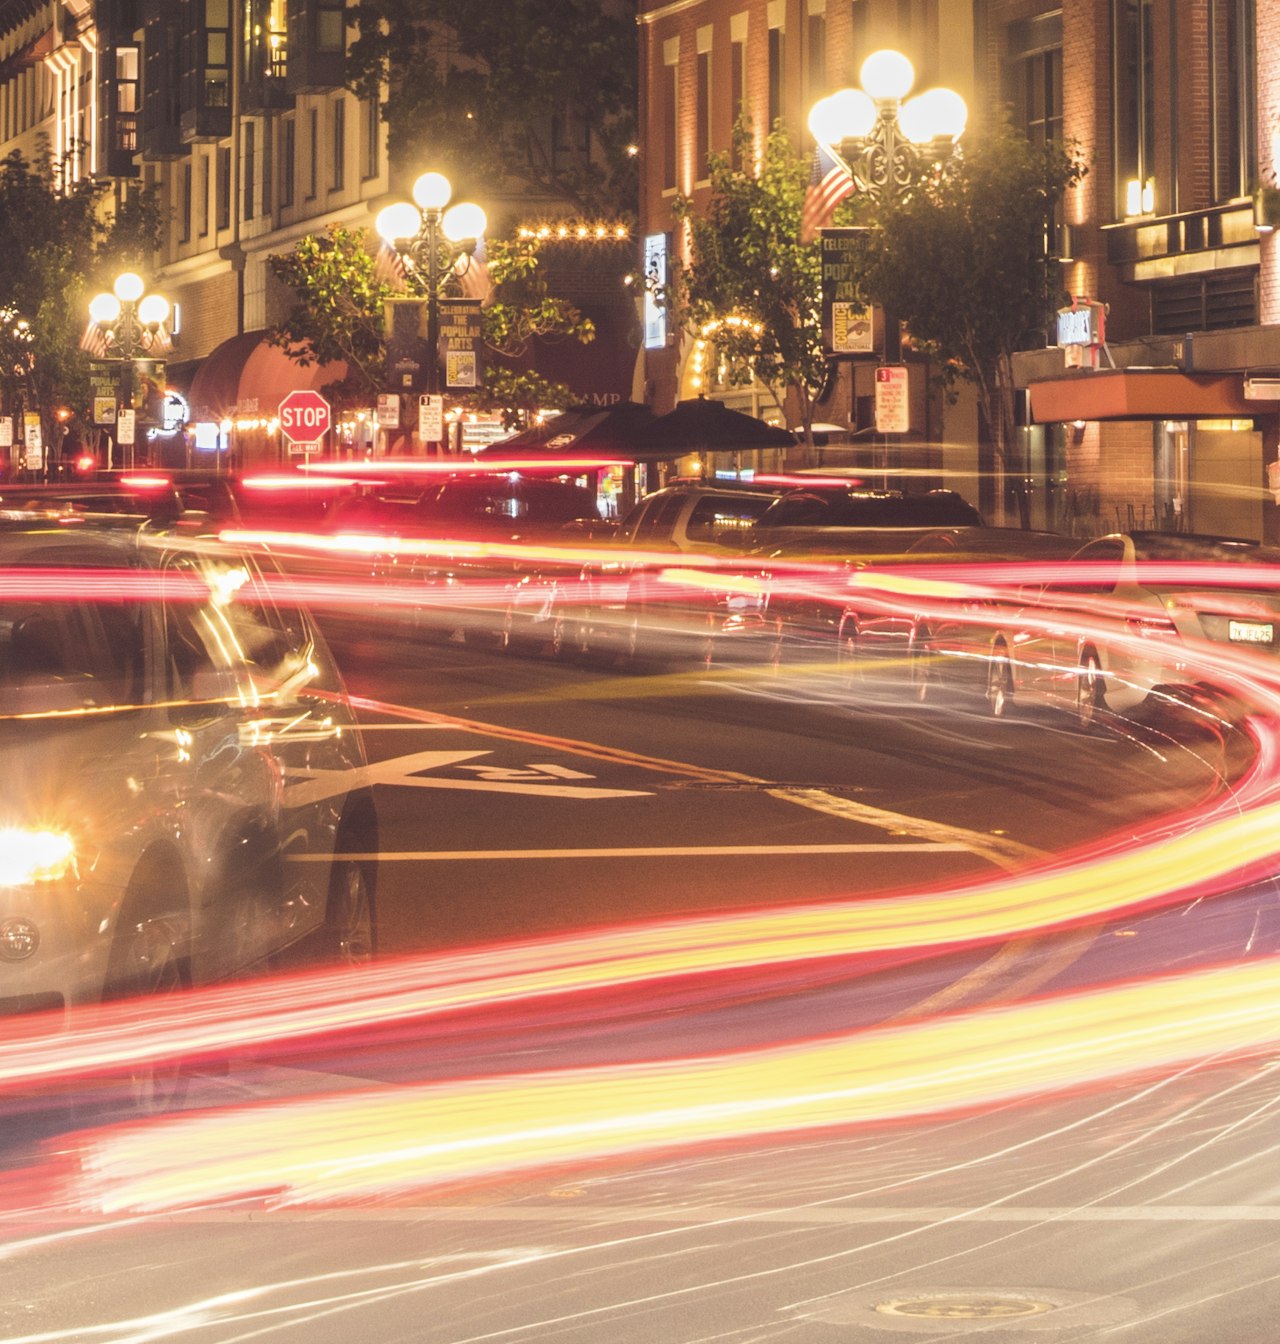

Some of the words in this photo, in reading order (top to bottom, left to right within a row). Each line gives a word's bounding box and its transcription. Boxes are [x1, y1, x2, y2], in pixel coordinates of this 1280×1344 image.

[453, 315, 468, 325] THE
[835, 307, 848, 345] COMIC
[441, 326, 481, 337] POPULAR
[448, 338, 473, 350] ARTS
[880, 370, 887, 382] 3
[282, 407, 326, 428] STOP
[305, 444, 318, 452] WAY
